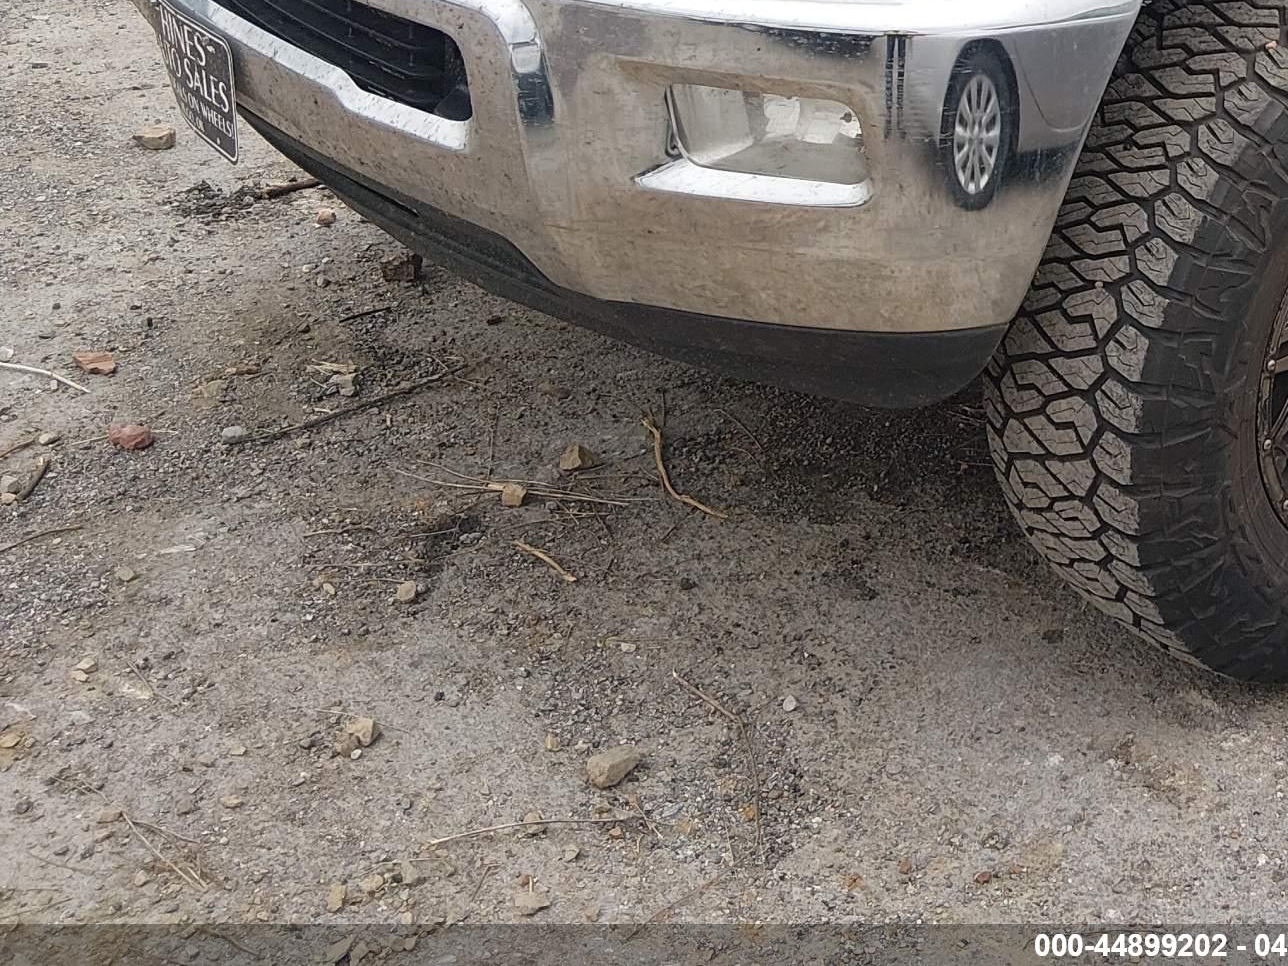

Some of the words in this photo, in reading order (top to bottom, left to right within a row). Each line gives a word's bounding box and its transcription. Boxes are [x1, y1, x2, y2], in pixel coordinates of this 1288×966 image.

[159, 4, 206, 67] HINES
[183, 57, 229, 113] SALES
[187, 92, 201, 115] ON
